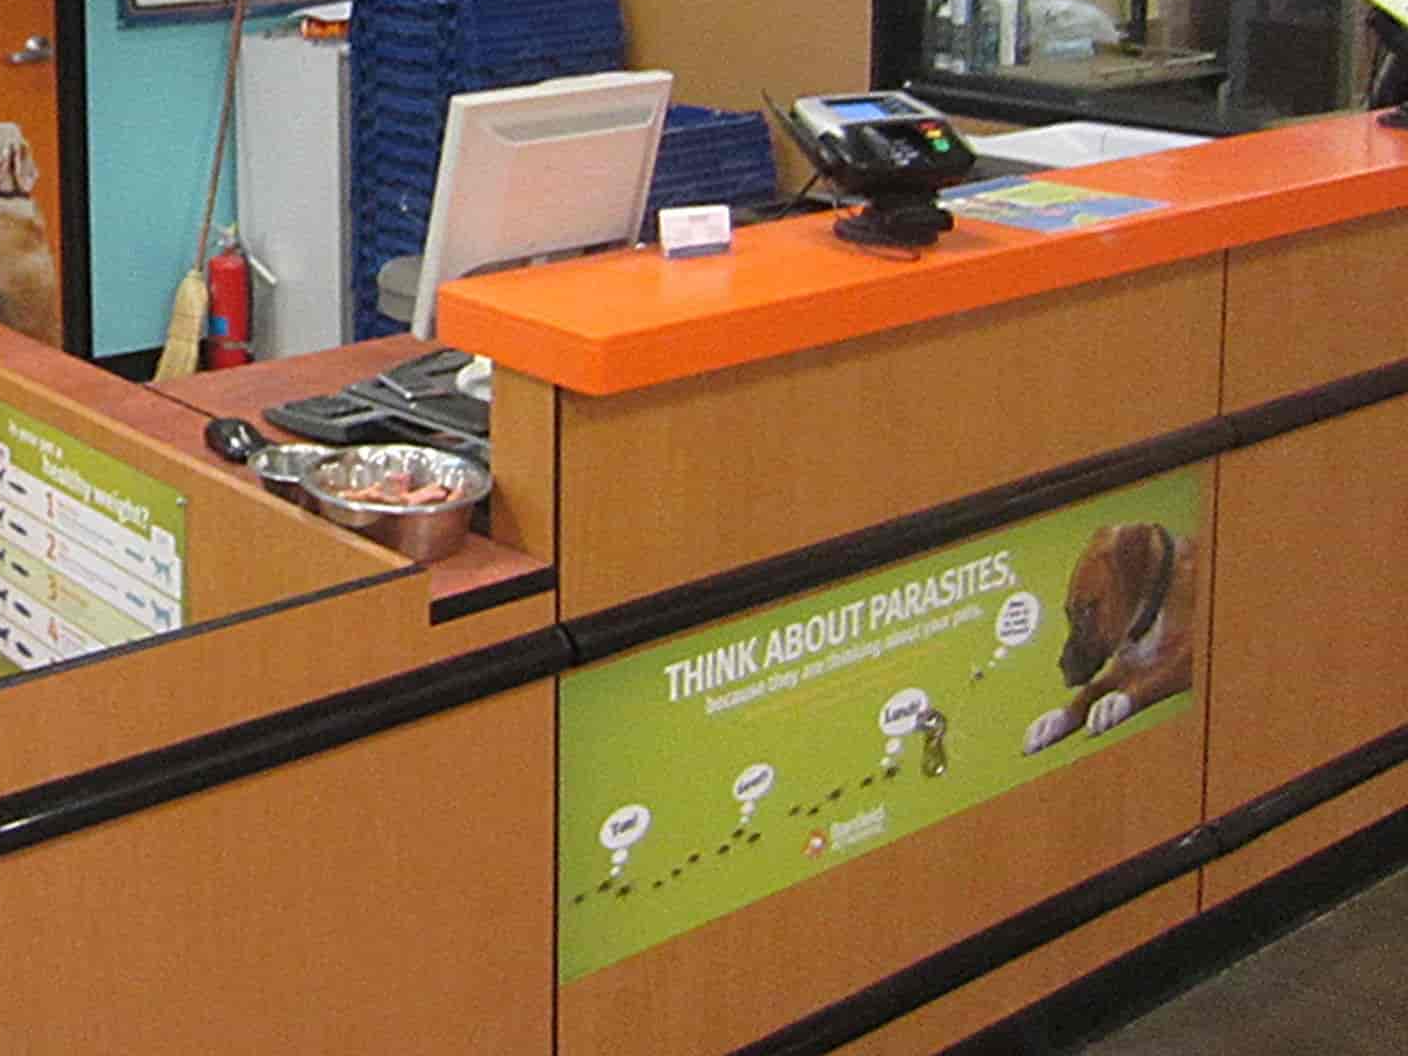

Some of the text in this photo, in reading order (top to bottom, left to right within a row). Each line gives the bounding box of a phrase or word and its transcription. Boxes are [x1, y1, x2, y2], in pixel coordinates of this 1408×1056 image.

[664, 636, 760, 703] THINK
[762, 601, 867, 669] ABOUT
[869, 550, 1017, 631] PARASITES.
